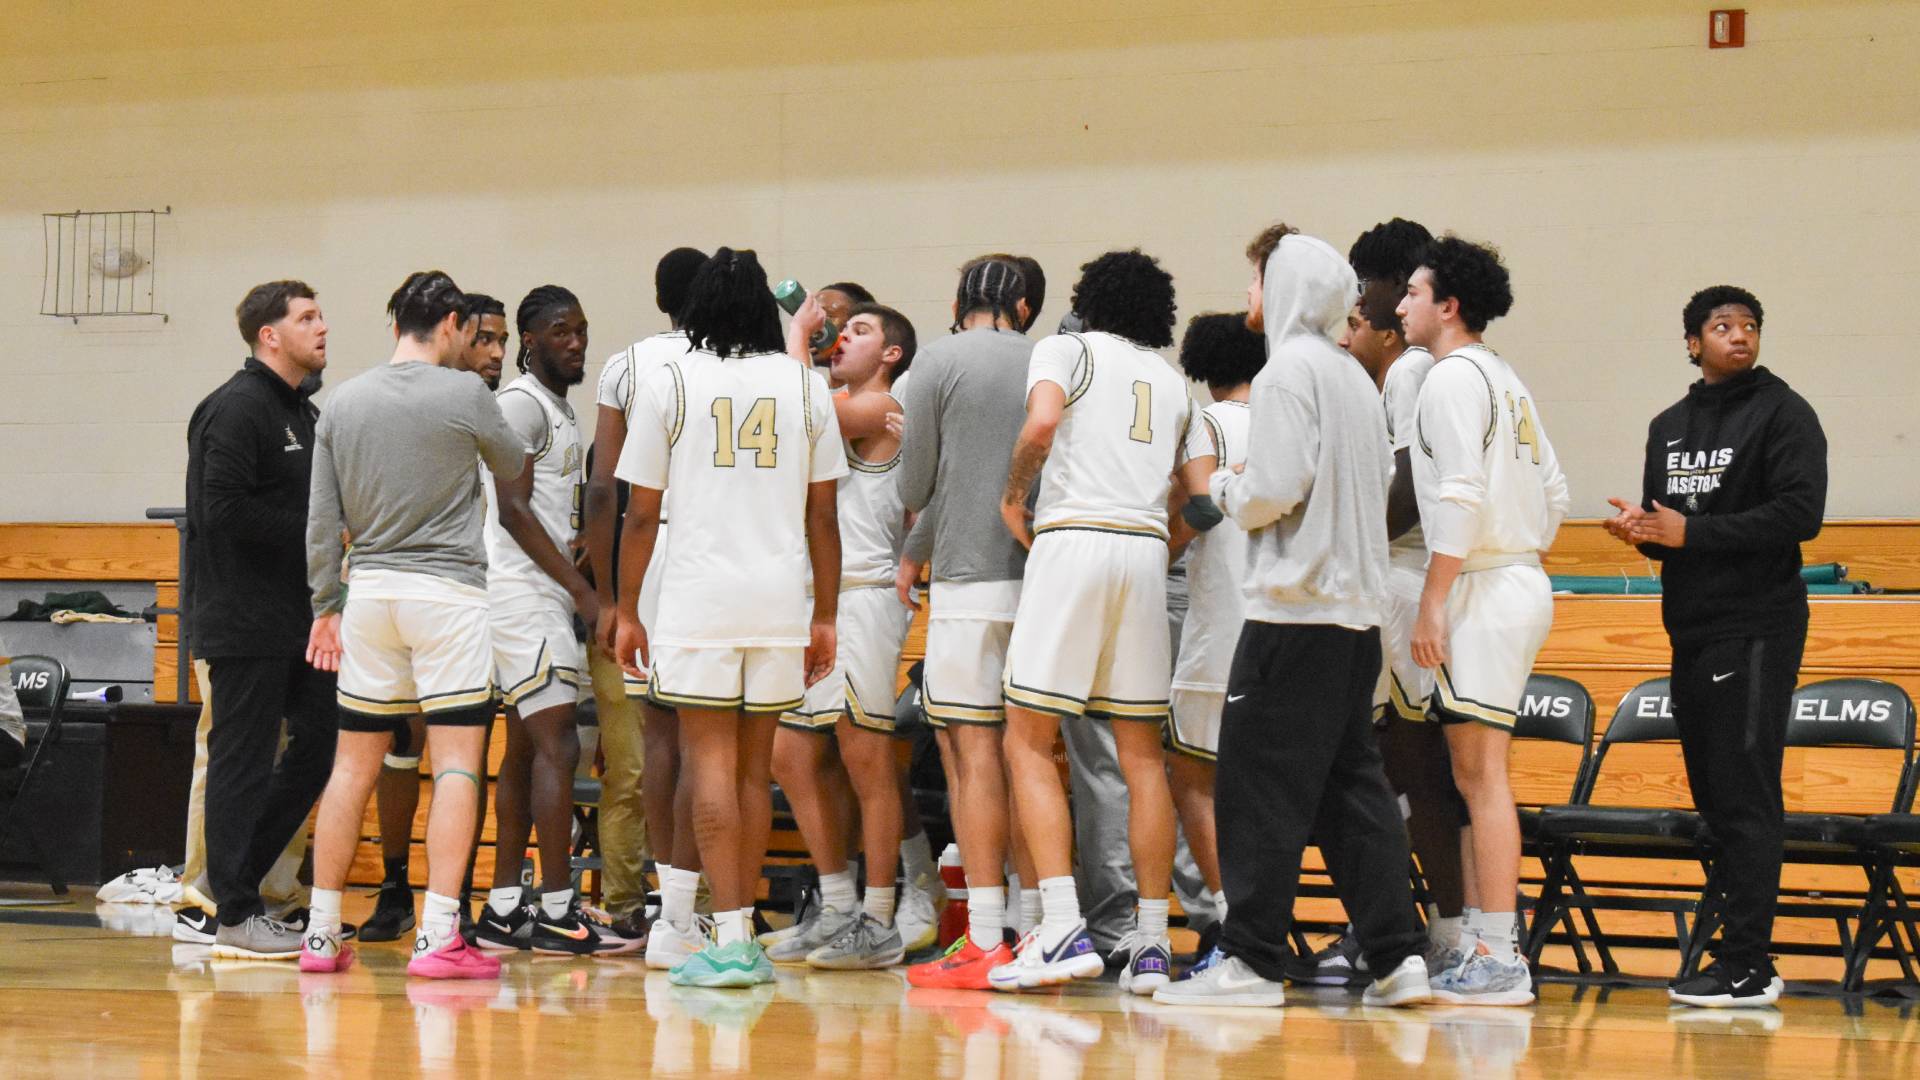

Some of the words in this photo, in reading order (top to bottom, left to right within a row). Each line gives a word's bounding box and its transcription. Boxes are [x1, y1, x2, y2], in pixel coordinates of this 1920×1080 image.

[1129, 380, 1152, 444] 1
[711, 397, 778, 468] 14
[1505, 390, 1540, 465] 14
[12, 672, 50, 690] MS
[1516, 695, 1573, 717] MS
[1637, 696, 1673, 718] EL
[1794, 699, 1893, 721] ELMS
